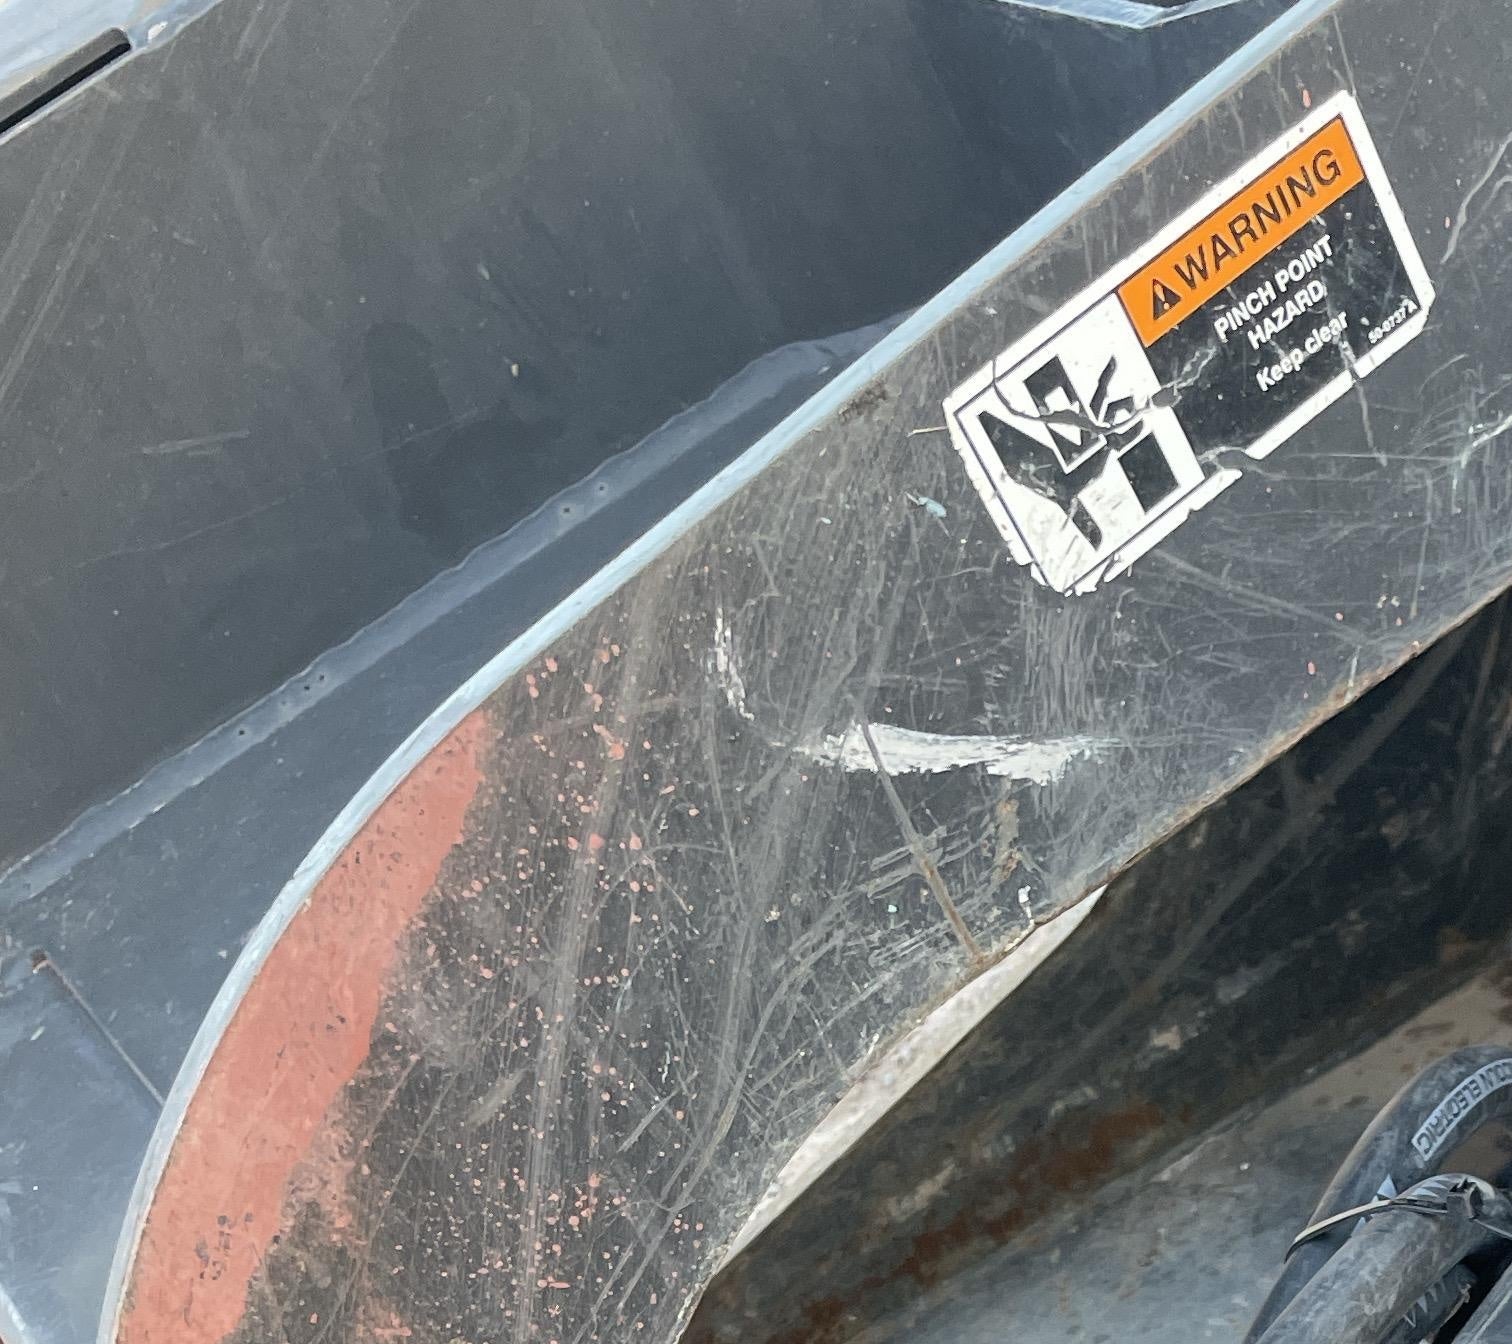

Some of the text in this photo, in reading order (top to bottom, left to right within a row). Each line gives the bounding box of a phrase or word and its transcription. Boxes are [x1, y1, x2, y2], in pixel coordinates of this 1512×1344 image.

[1174, 148, 1343, 287] WARNING
[1213, 235, 1334, 341] PINCH POINT
[1248, 279, 1329, 350] HAZARD
[1255, 311, 1350, 392] Keep clear
